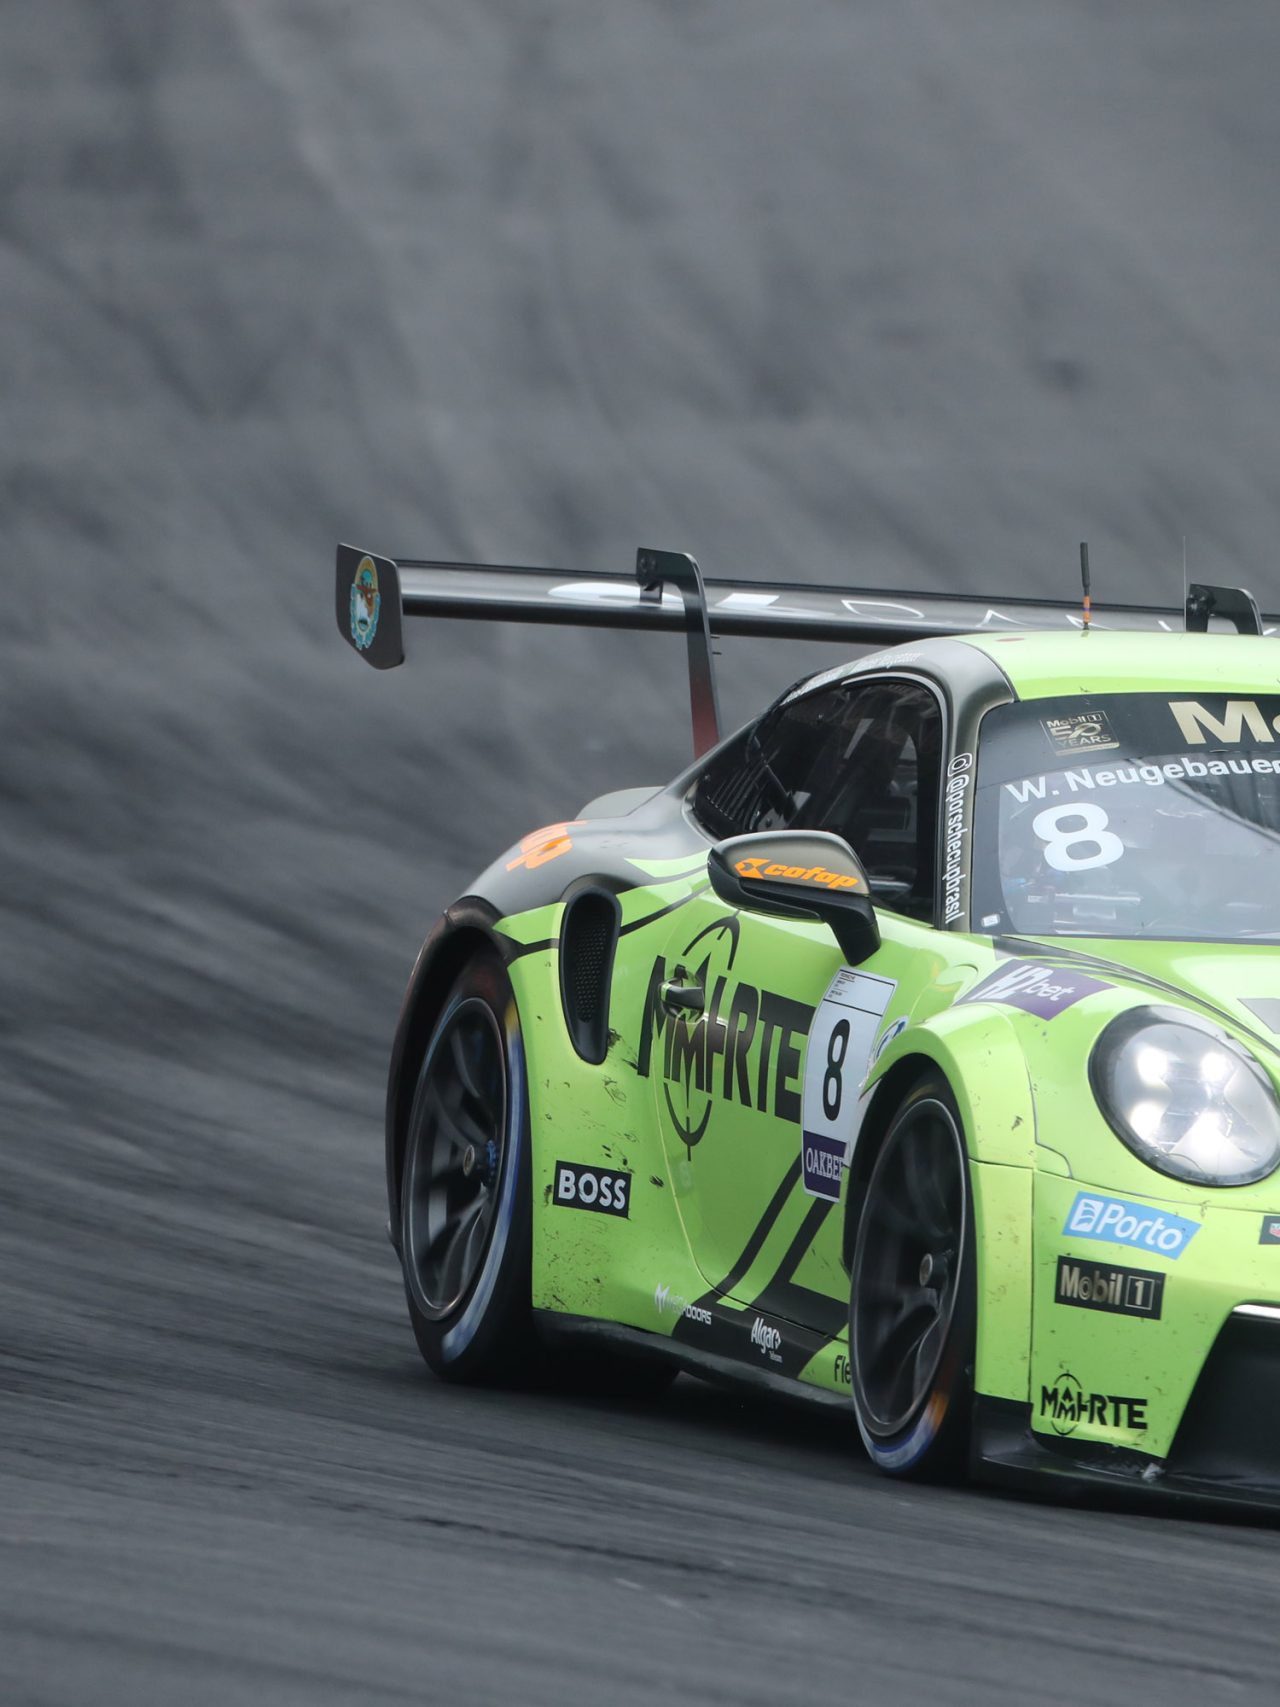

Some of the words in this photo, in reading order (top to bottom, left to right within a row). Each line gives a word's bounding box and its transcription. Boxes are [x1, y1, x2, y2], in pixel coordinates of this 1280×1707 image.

[1046, 715, 1087, 728] Mobil
[1056, 735, 1113, 747] YEARS
[1004, 775, 1060, 803] W.
[942, 774, 970, 924] @porschecupbrasil
[1031, 802, 1125, 872] 8
[764, 863, 858, 889] cofap
[822, 1019, 850, 1122] 8
[558, 1168, 627, 1210] BOSS
[1100, 1203, 1184, 1251] Porto
[1060, 1264, 1123, 1305] Mobil
[1135, 1280, 1144, 1305] 1
[751, 1317, 777, 1354] Algar
